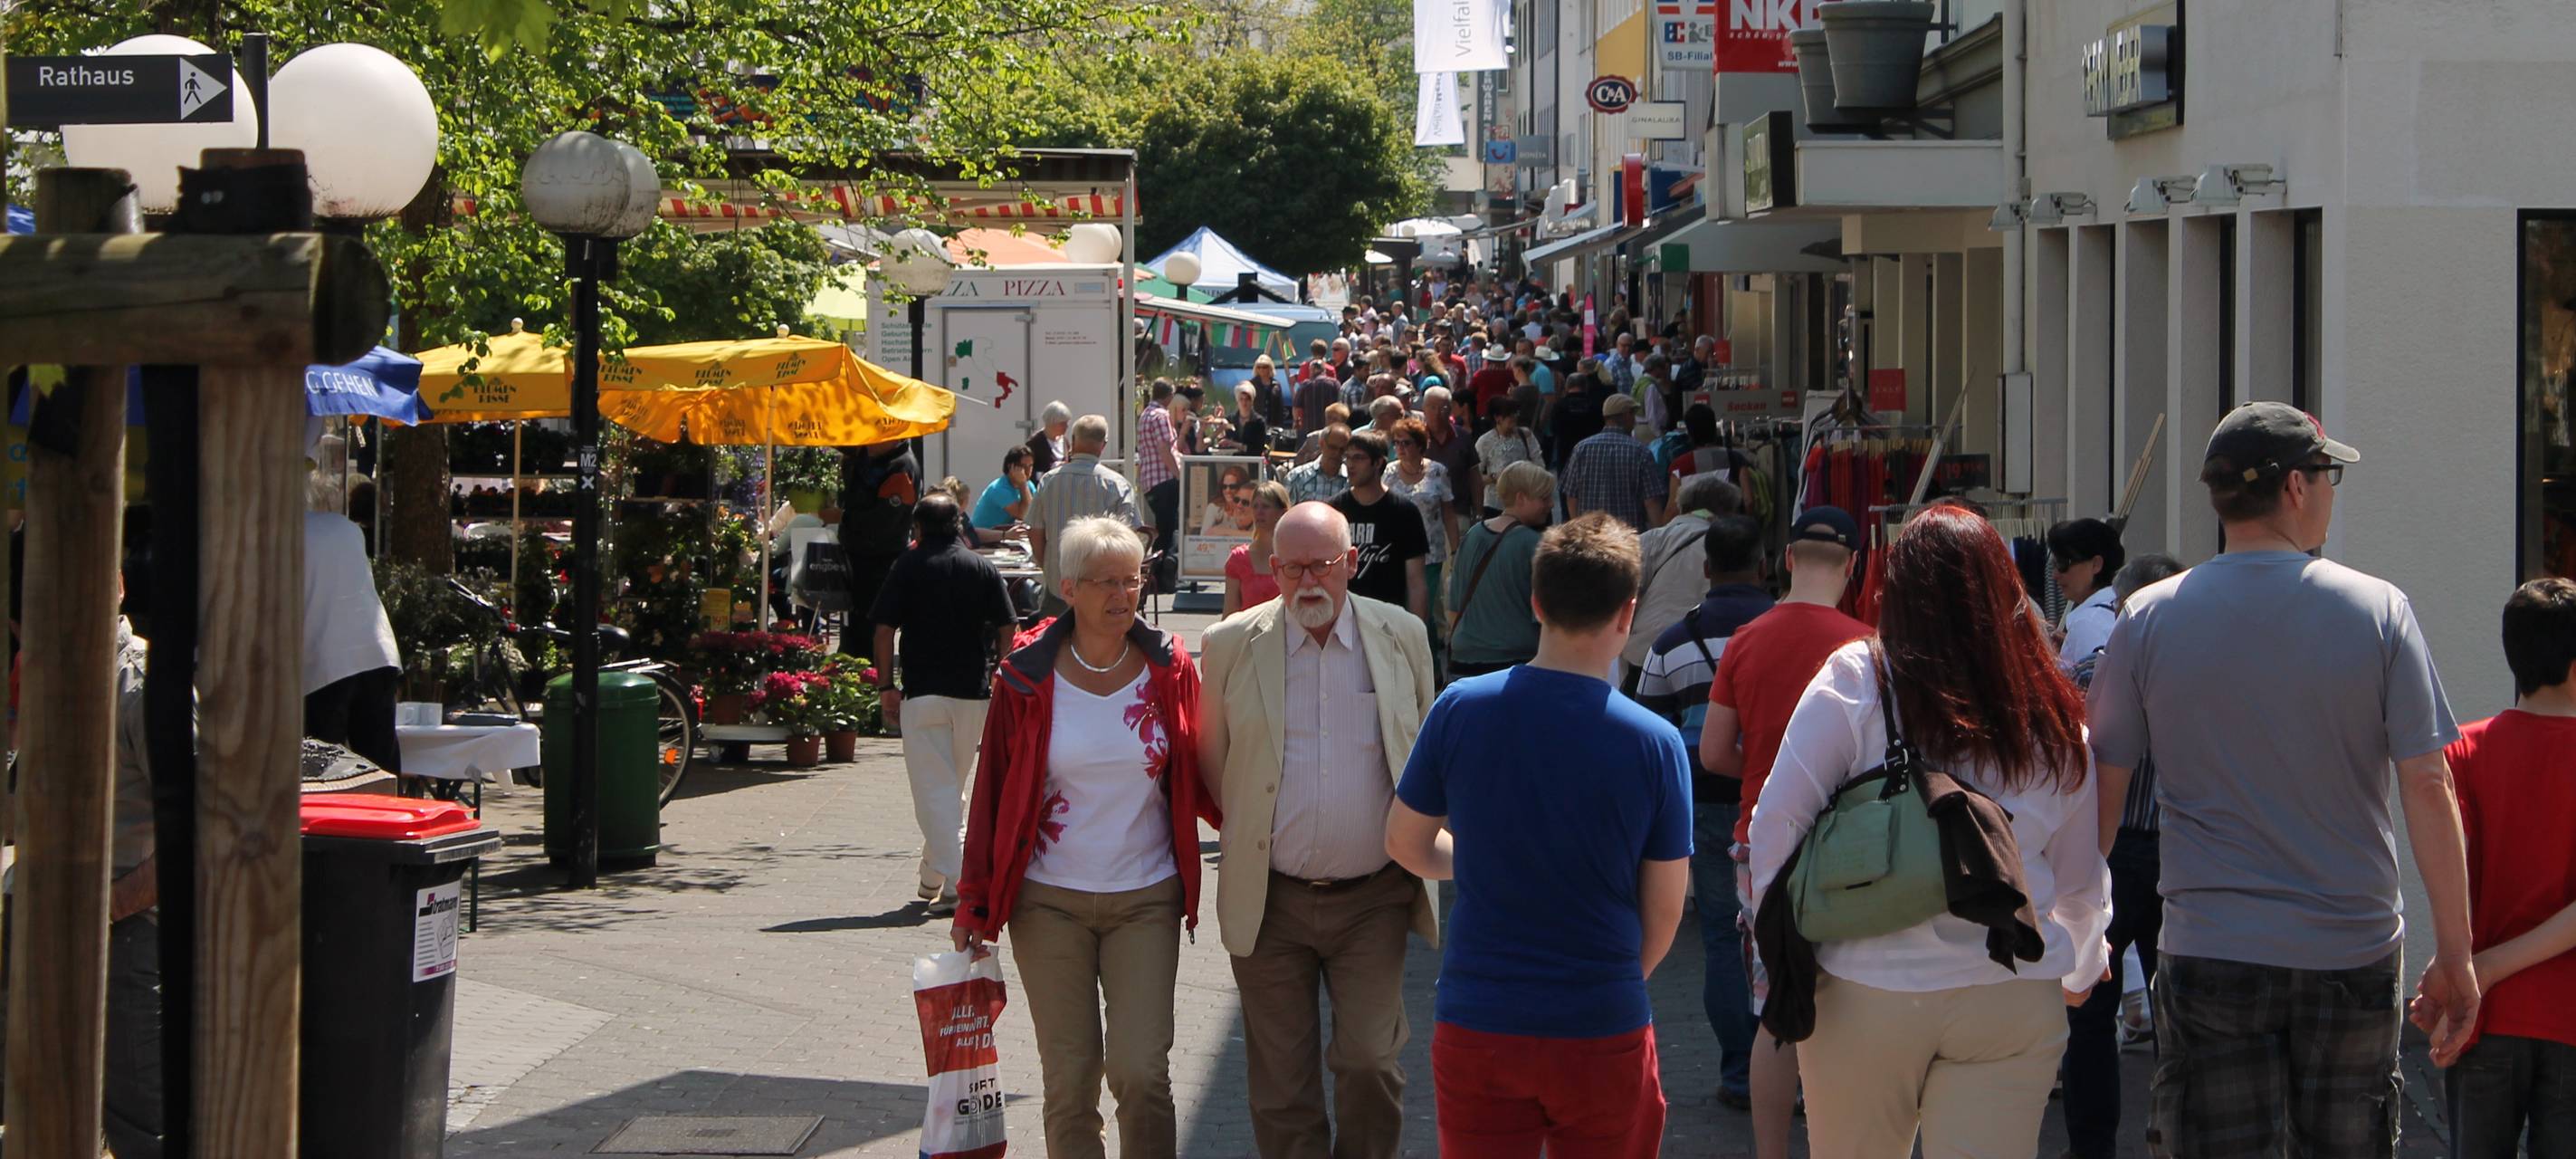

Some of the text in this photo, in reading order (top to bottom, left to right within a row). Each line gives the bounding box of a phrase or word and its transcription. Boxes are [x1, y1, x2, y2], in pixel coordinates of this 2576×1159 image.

[39, 65, 135, 87] Rathaus
[1596, 84, 1627, 104] C&A
[1004, 280, 1066, 296] PIZZA
[580, 454, 596, 467] M2
